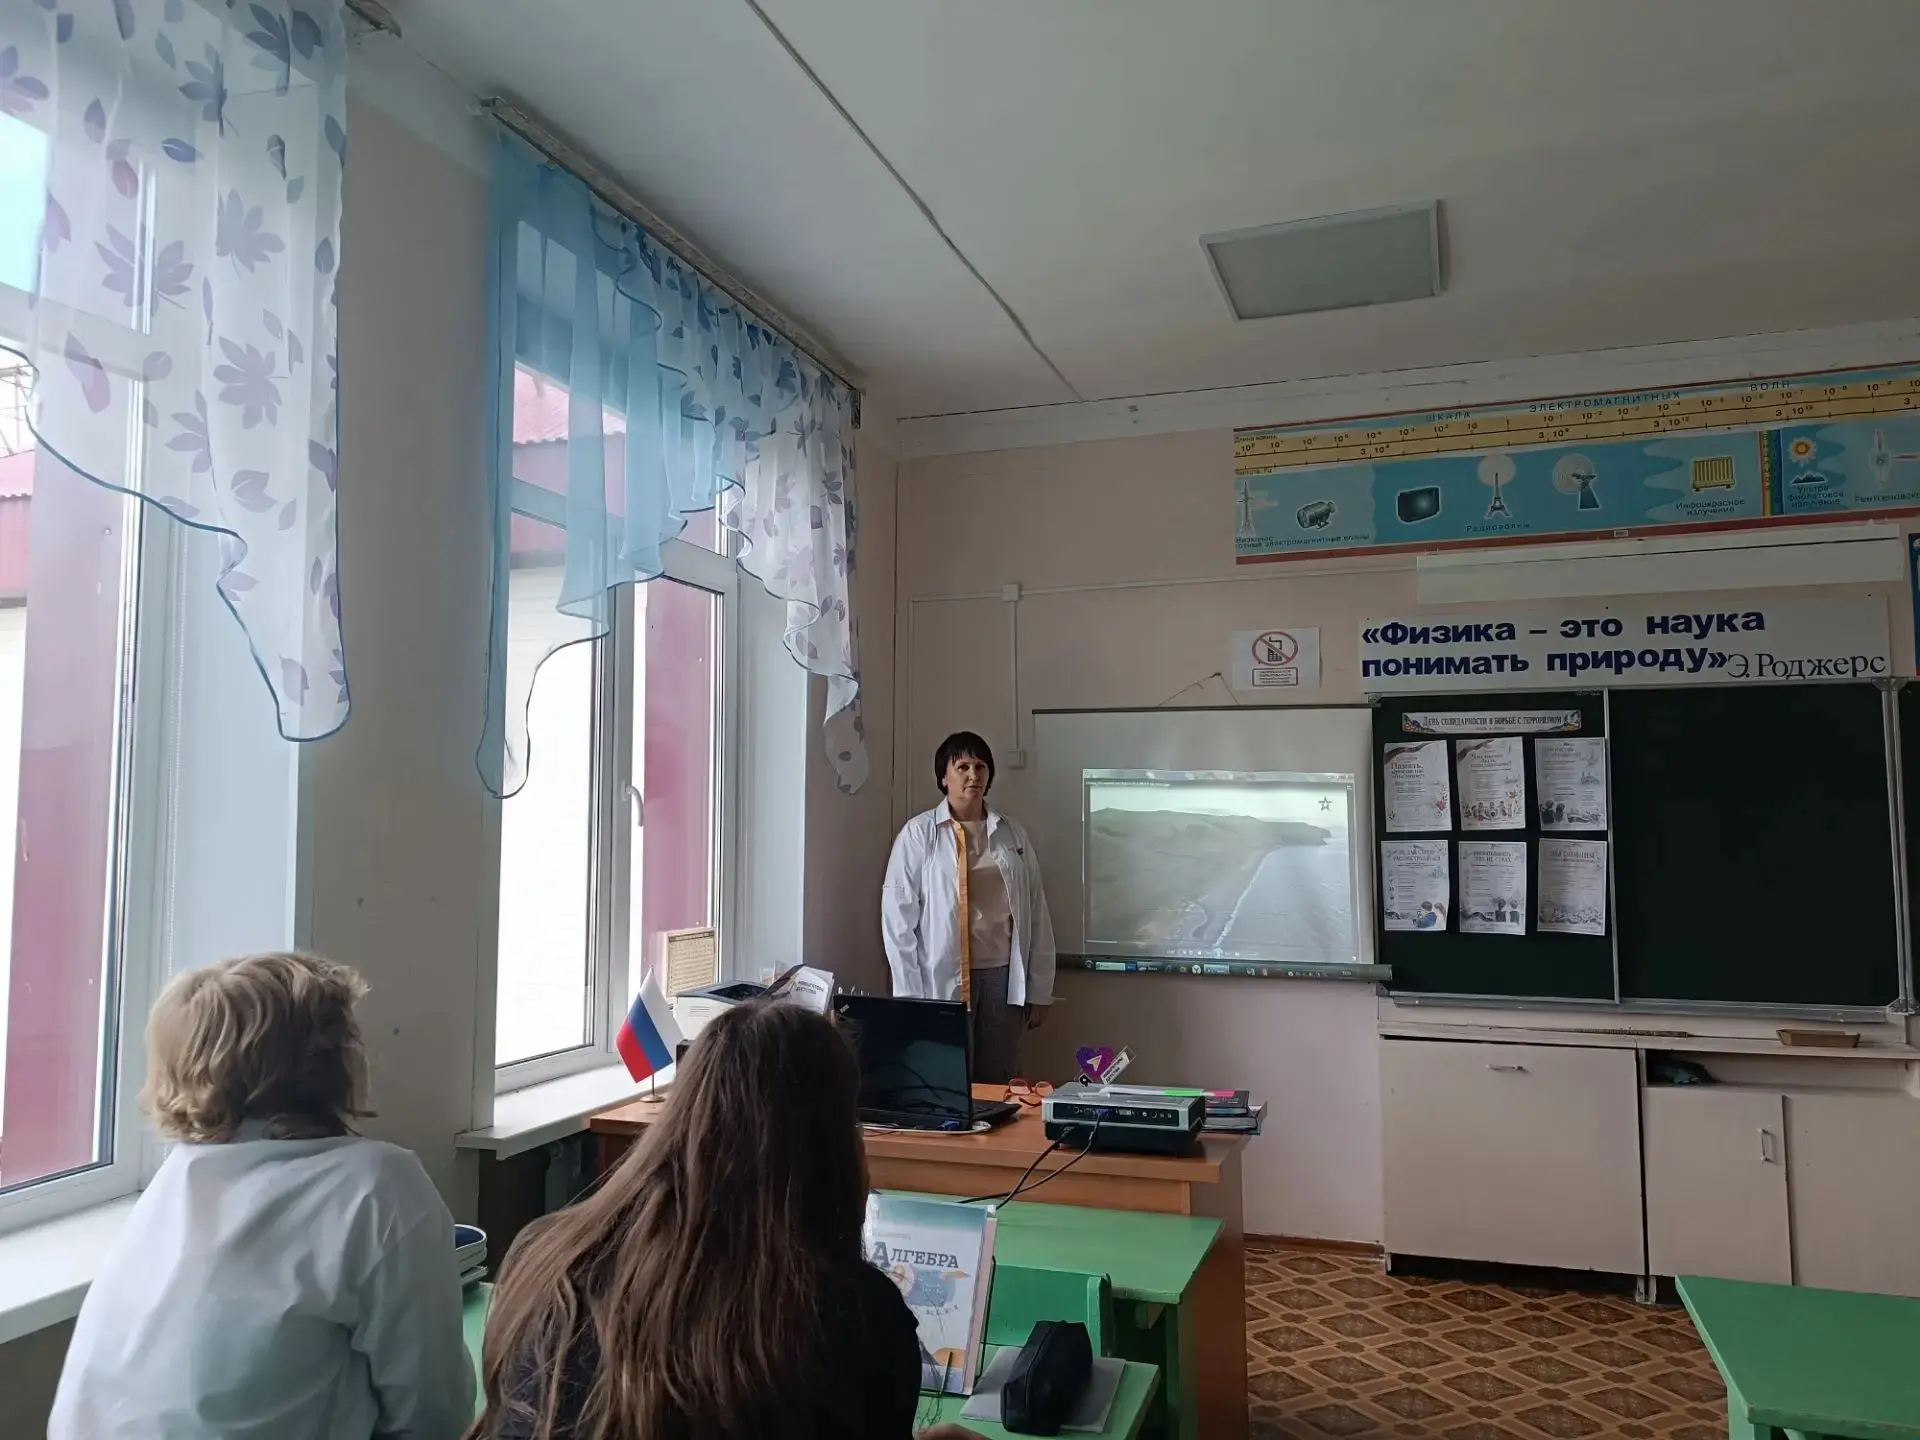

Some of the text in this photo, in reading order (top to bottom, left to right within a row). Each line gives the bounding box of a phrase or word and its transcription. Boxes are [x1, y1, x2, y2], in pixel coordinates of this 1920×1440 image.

[1425, 380, 1789, 423] ШКАЛА ЭЛЕКТРОМАГНИТНЫХ ВОЛН
[1775, 409, 1783, 418] 3
[1903, 397, 1911, 405] 3
[1675, 500, 1746, 511] Инфракрасное
[1465, 523, 1532, 533] Радиоволны
[1361, 621, 1516, 647] «Физика
[1559, 618, 1623, 639] это
[1646, 611, 1767, 641] наука
[1361, 646, 1728, 678] понимать природу»
[1728, 652, 1887, 681] Э. Роджерс
